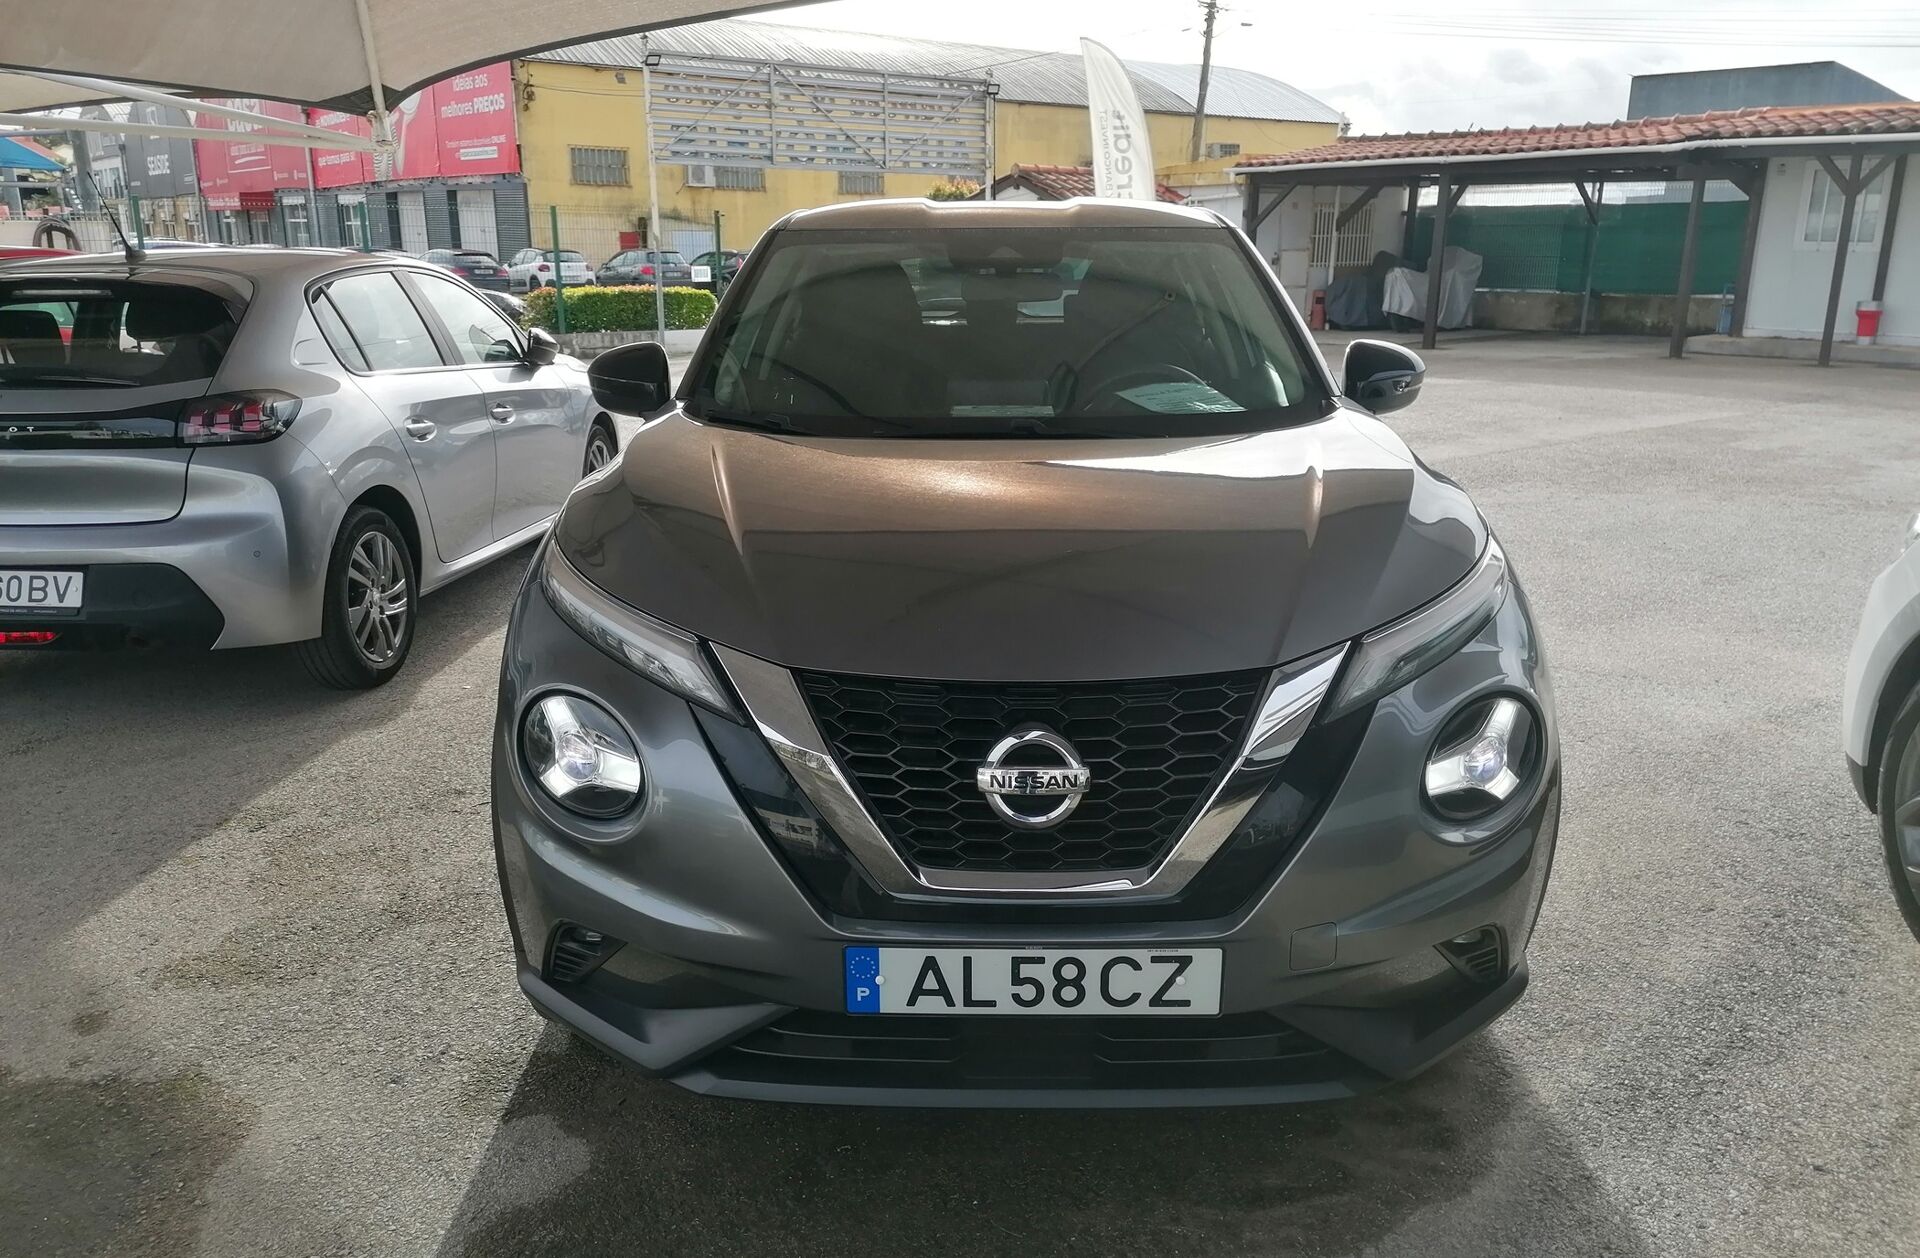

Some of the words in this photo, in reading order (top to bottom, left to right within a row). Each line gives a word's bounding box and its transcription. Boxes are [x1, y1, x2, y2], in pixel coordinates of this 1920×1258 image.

[474, 73, 488, 88] aos
[441, 101, 473, 119] melhores
[474, 93, 505, 115] PREÇOS
[990, 774, 1079, 790] NISSAN
[857, 987, 871, 1002] P
